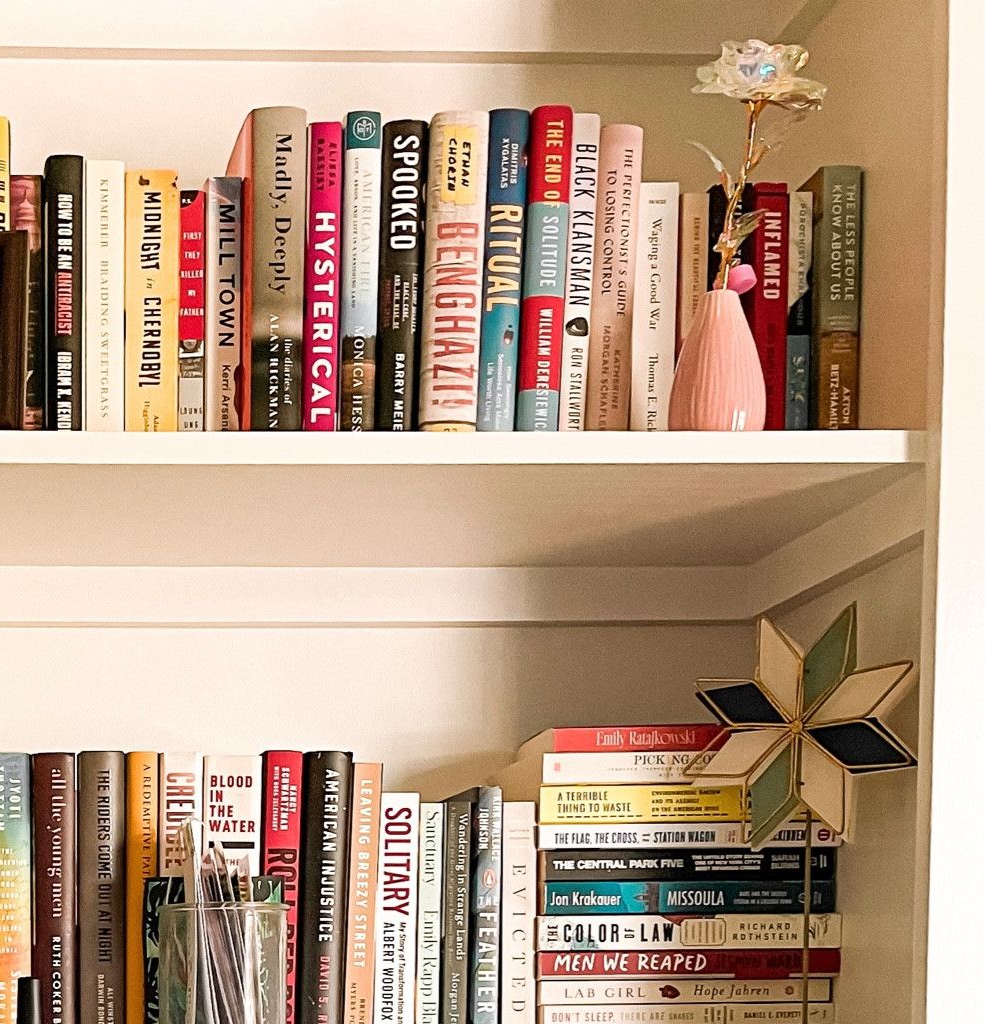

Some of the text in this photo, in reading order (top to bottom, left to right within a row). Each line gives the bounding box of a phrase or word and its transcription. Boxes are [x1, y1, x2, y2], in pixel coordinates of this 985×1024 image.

[461, 142, 470, 187] ETHAN
[268, 132, 293, 296] Madly, Deeply
[390, 135, 419, 250] SPOOKED
[141, 192, 161, 270] MIDNIGHT
[183, 231, 201, 240] FIRST
[569, 143, 597, 307] BLACK KLANSMAN
[184, 251, 200, 260] THEY
[218, 204, 236, 347] MILL TOWN
[486, 204, 523, 312] RITUAL
[762, 211, 781, 300] INFLAMED
[311, 211, 335, 423] HYSTERICAL
[432, 222, 479, 406] BENGHAZI!
[139, 297, 161, 388] CHERNOBYL
[596, 730, 696, 746] Emily Ratajkowski
[210, 775, 252, 788] BLOOD
[210, 790, 223, 802] IN
[209, 820, 255, 833] WATER
[210, 804, 233, 817] THE
[382, 808, 412, 916] SOLITARY
[550, 892, 622, 906] Jon Krakauer
[667, 891, 724, 907] MISSOULA
[511, 864, 526, 1012] EVICTED
[547, 923, 674, 942] THE COLOR OF LAW
[554, 954, 707, 971] MEN WE REAPED
[565, 988, 645, 998] LAB GIRL
